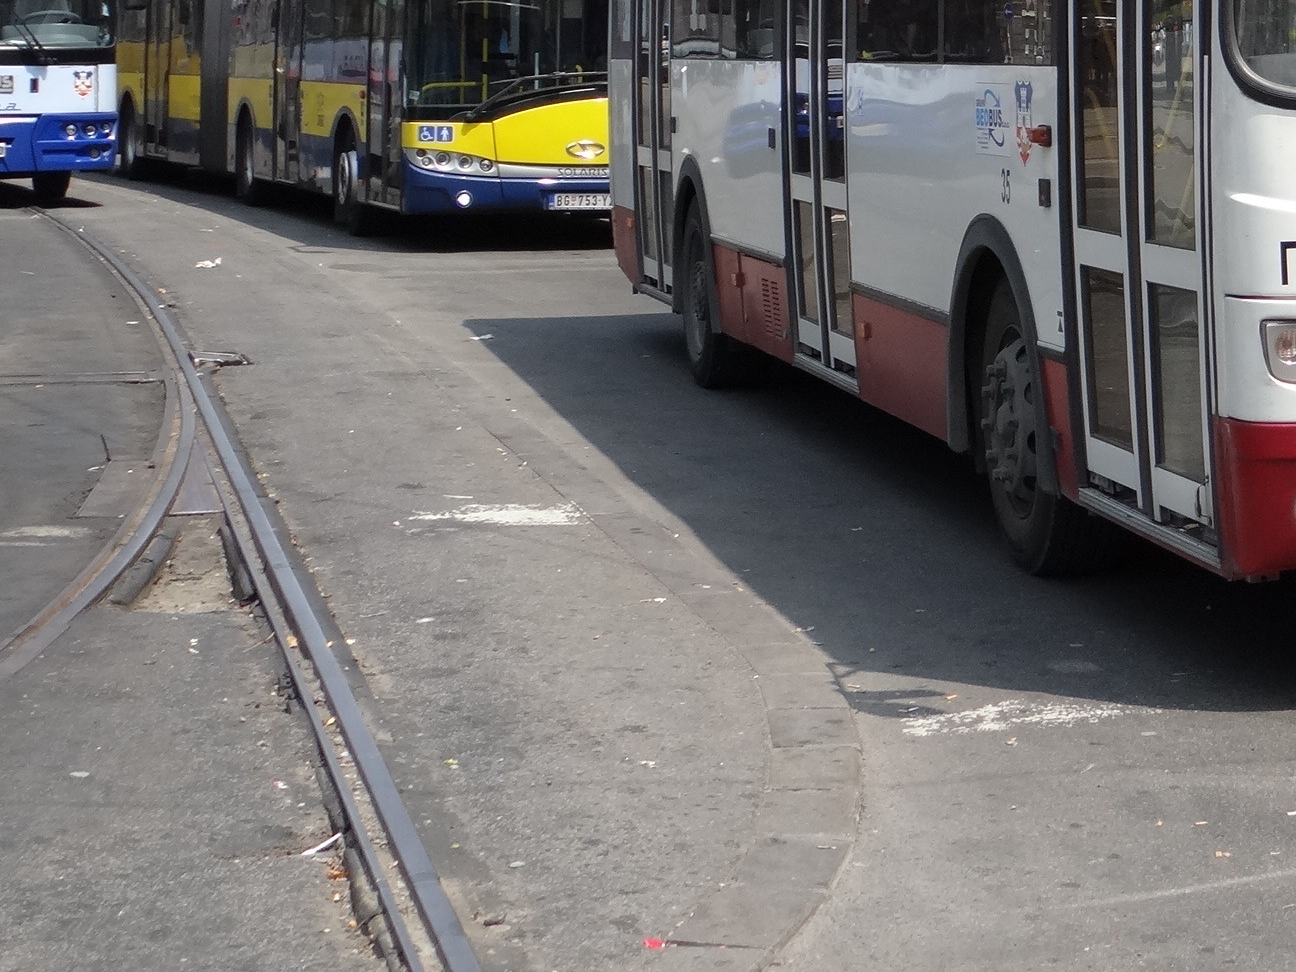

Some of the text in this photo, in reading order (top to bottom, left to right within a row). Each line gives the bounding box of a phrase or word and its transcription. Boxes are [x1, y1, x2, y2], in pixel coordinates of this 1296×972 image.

[557, 168, 609, 177] SOLARIS
[1000, 168, 1011, 204] 35
[556, 195, 613, 206] BG 753-Y
